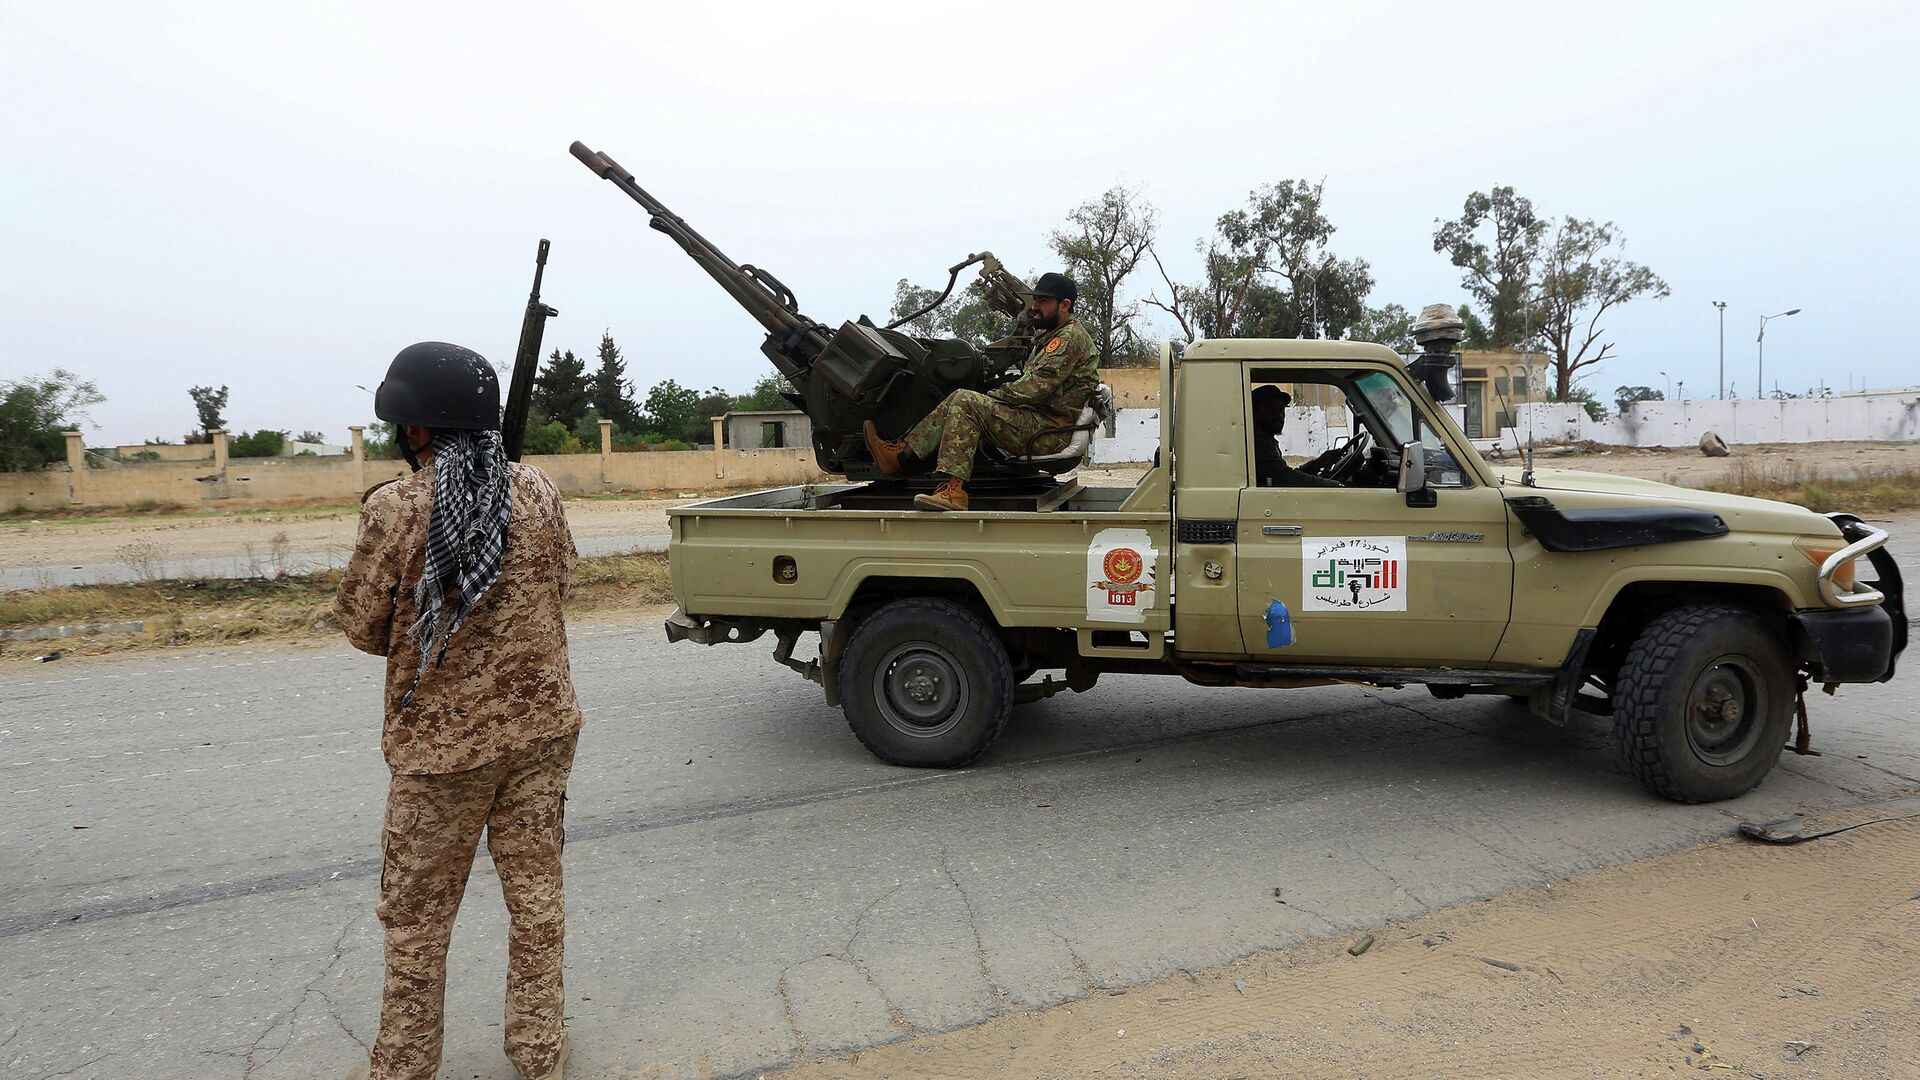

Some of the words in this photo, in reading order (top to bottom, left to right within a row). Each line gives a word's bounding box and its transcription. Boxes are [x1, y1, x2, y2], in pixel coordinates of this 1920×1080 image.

[1317, 540, 1346, 558] فبراير
[1363, 540, 1390, 554] ثورة
[1315, 594, 1352, 607] طرابلس
[1358, 592, 1391, 609] شارع
